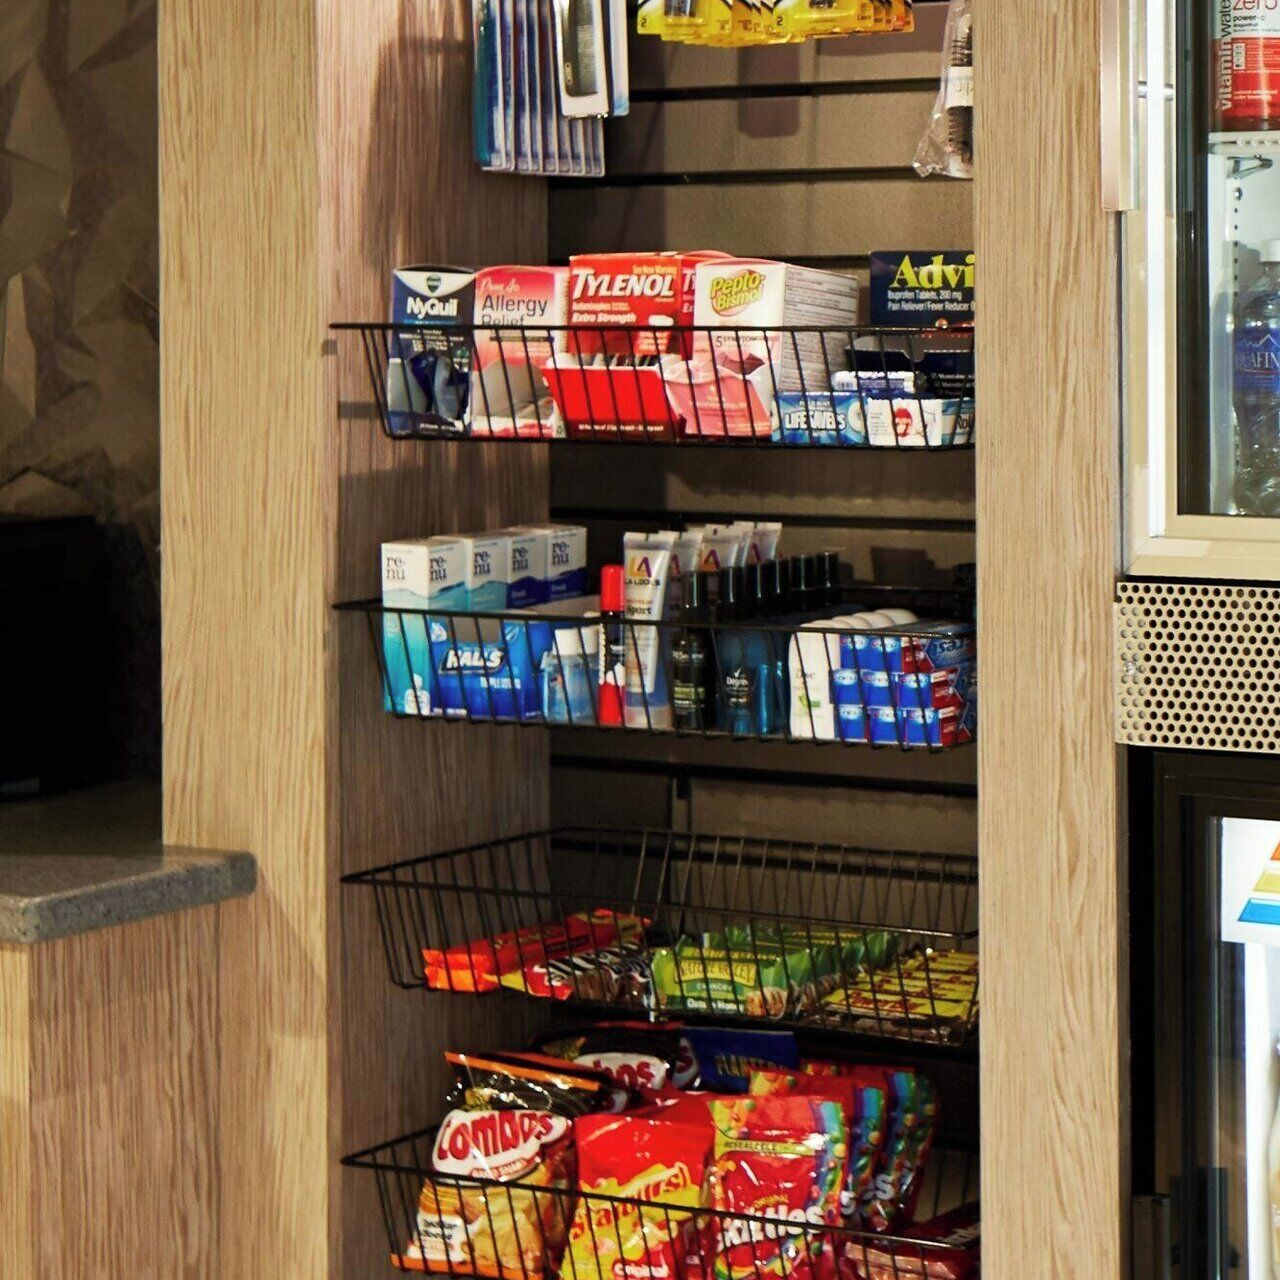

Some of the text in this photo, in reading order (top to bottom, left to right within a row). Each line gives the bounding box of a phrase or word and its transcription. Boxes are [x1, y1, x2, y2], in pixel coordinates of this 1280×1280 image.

[889, 254, 975, 289] Advi
[572, 271, 676, 300] TYLENOL
[406, 296, 459, 319] NyQuil
[482, 294, 548, 317] Allergy
[571, 312, 637, 324] Extra Strength
[446, 649, 504, 669] HALLS
[437, 1111, 554, 1161] Combos
